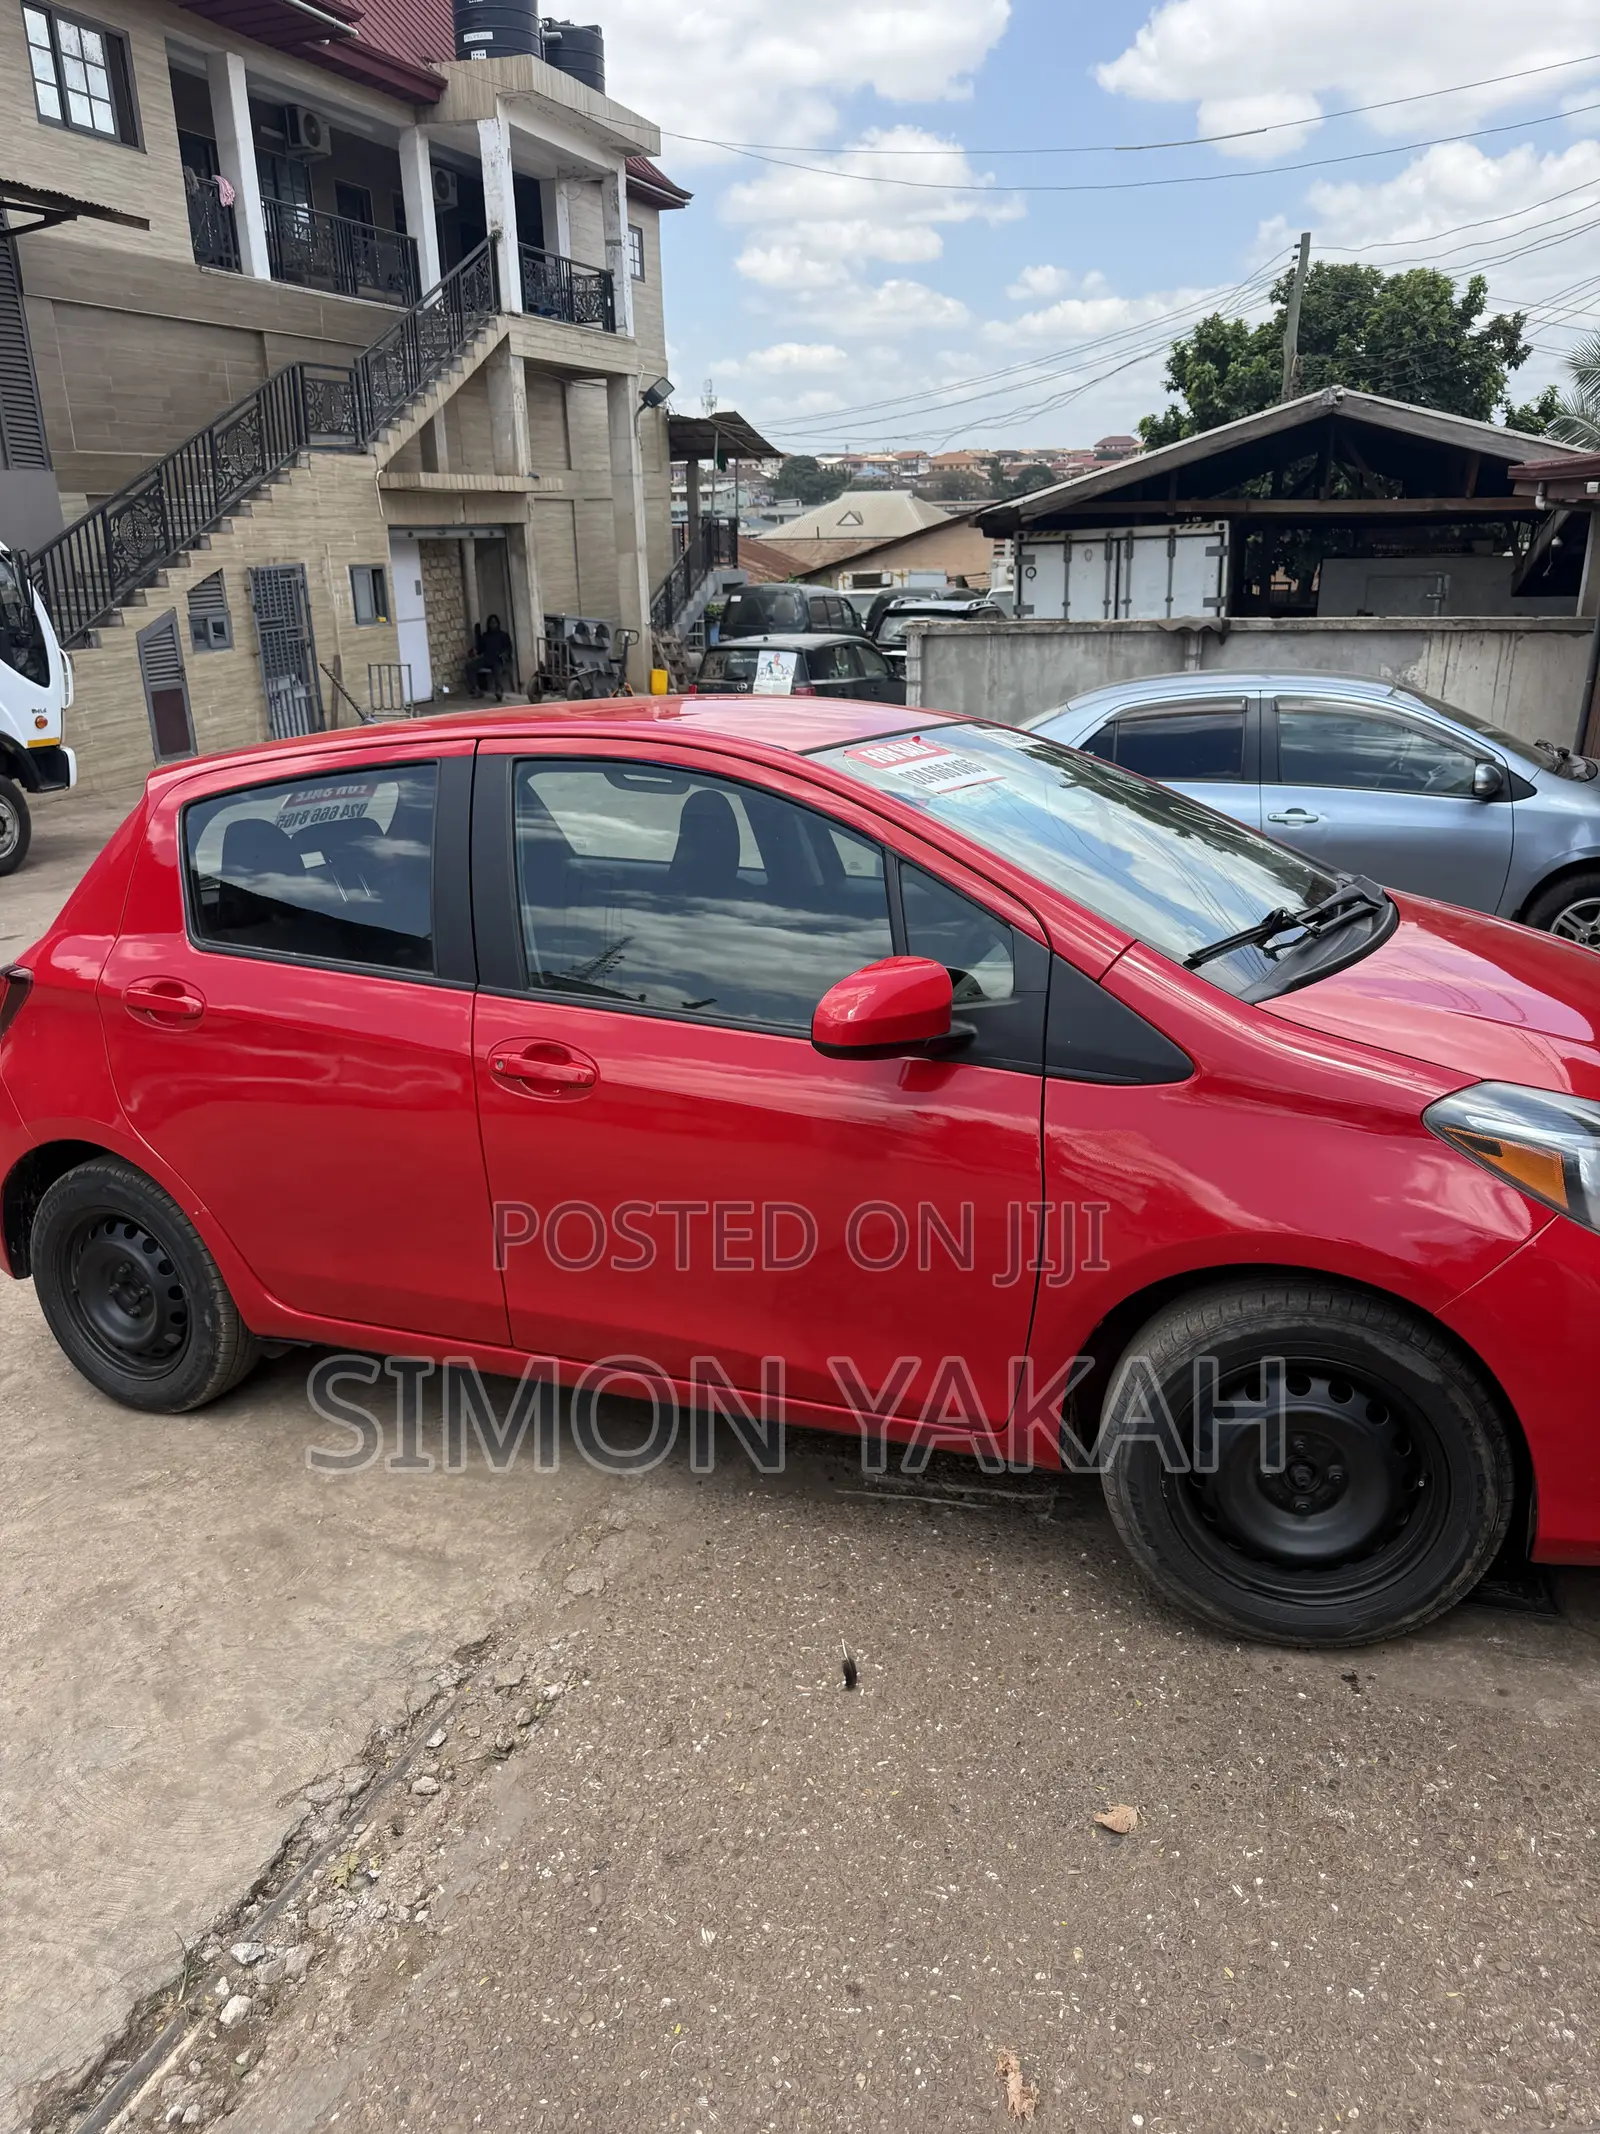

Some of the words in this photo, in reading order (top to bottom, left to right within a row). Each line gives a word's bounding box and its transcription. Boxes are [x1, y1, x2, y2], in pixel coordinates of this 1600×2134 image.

[859, 747, 904, 764] FOR
[888, 741, 937, 758] SALE
[898, 769, 936, 785] 024
[921, 764, 955, 781] 666
